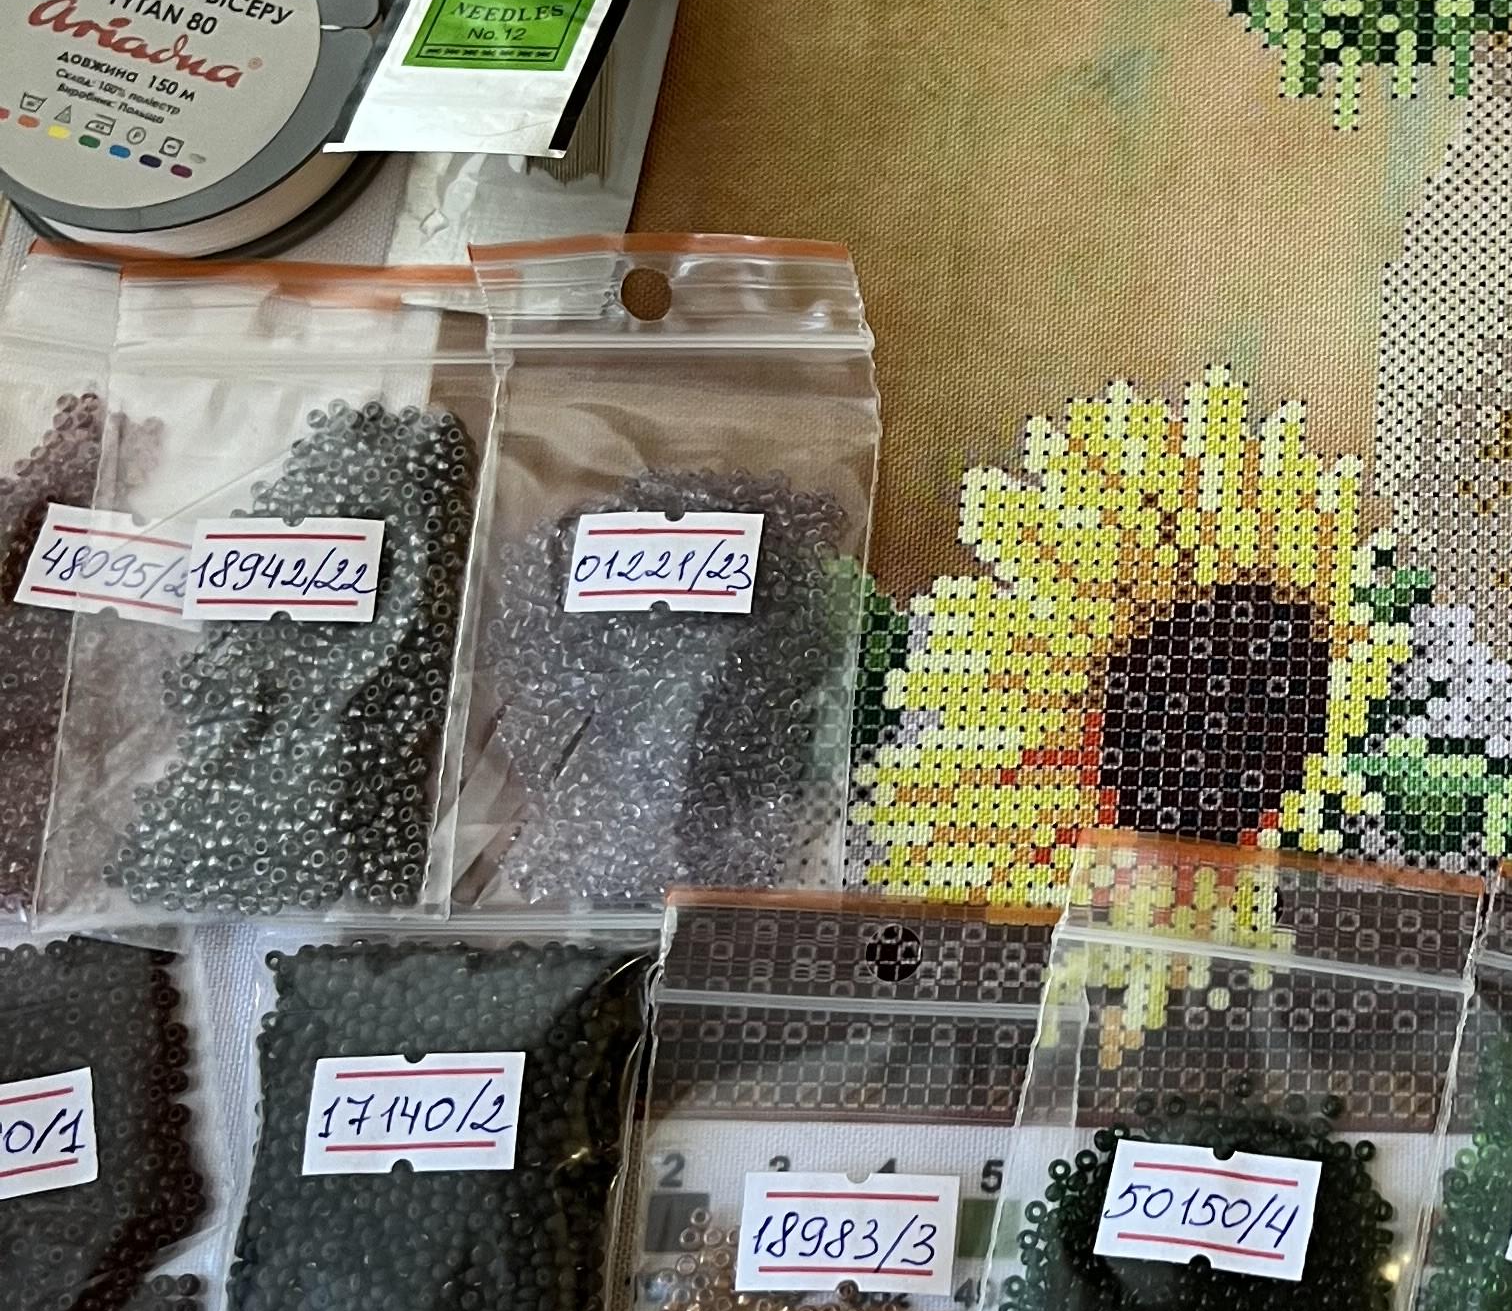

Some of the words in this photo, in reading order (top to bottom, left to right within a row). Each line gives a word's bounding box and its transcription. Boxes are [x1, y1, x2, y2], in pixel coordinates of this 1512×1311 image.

[186, 12, 217, 35] 80
[451, 2, 564, 21] NEEDLES
[504, 27, 527, 40] 12
[148, 75, 179, 95] 150
[41, 538, 186, 598] 48095/2
[190, 547, 376, 595] 18942/22
[0, 1108, 86, 1154] 0/1
[318, 1079, 512, 1138] 17140/2
[1104, 1183, 1300, 1248] 50150/4
[753, 1212, 937, 1273] 18983/3
